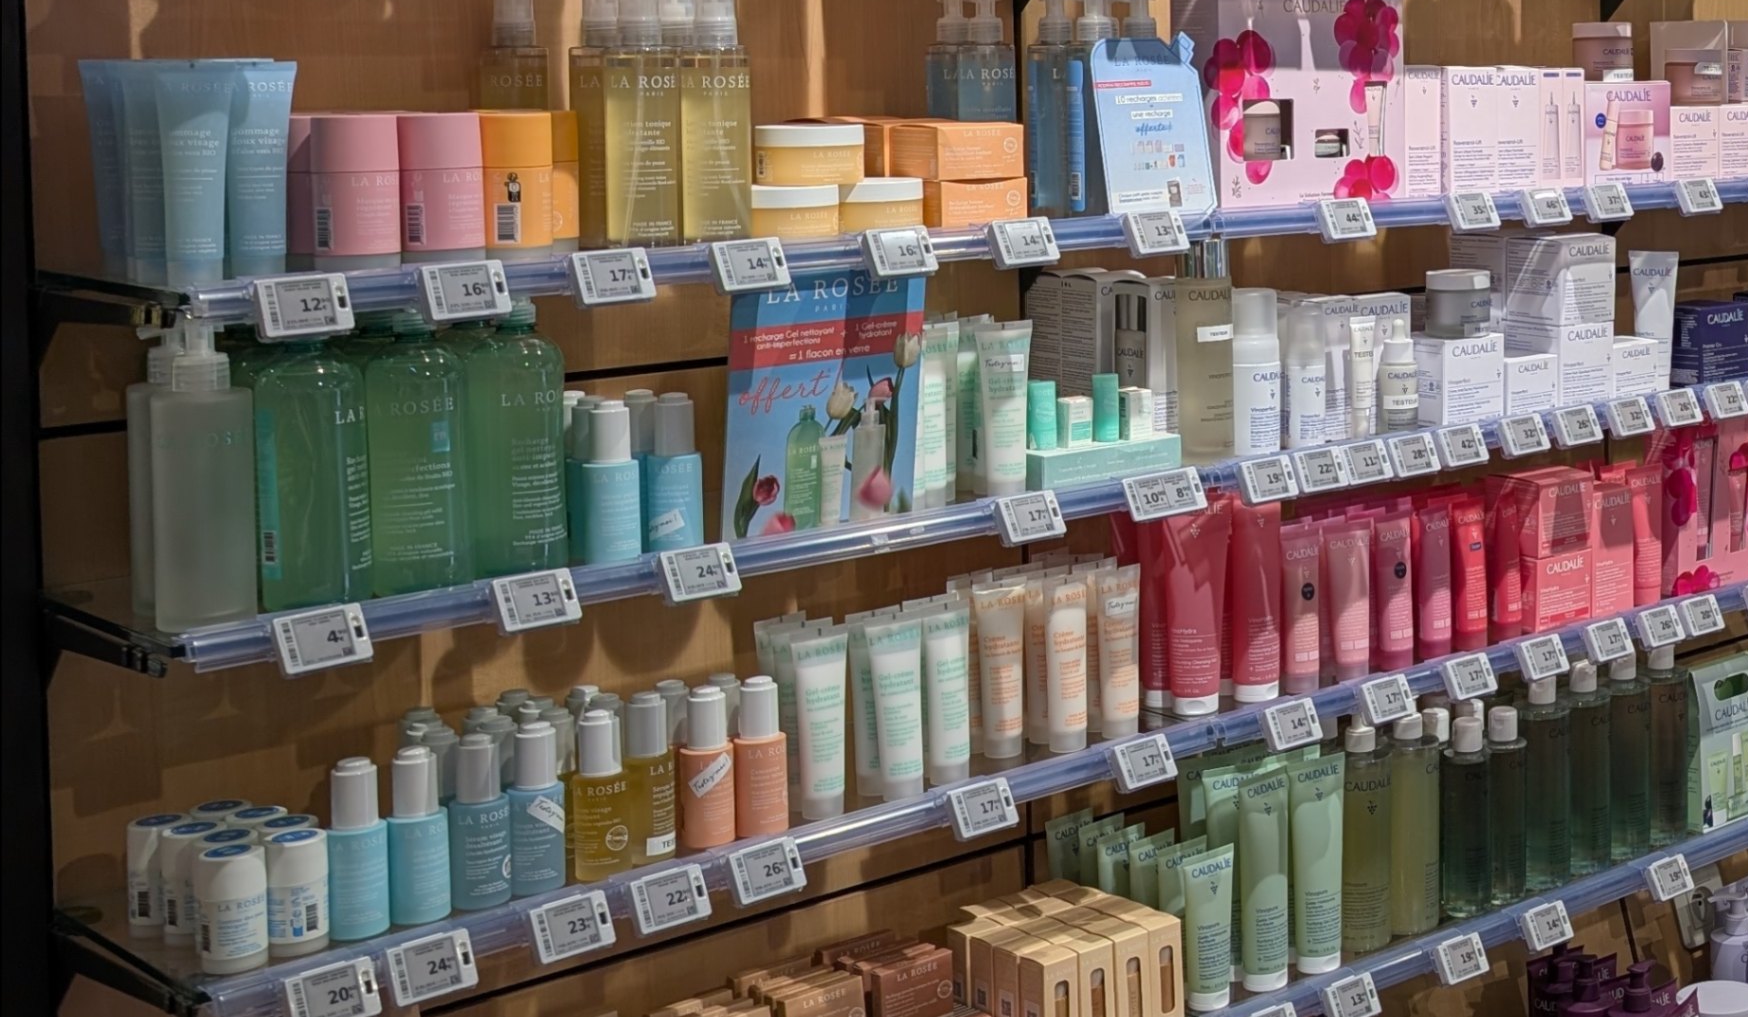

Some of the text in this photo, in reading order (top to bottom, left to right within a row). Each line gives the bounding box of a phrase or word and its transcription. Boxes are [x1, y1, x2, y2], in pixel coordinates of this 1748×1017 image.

[609, 268, 629, 283] 17
[461, 283, 482, 297] 16
[767, 276, 899, 305] LA ROSÉE
[301, 298, 322, 313] 12
[861, 318, 897, 331] Gel-crème
[750, 330, 785, 343] recharge
[785, 329, 799, 340] Gel
[800, 326, 836, 340] nettoyant
[858, 327, 893, 340] hydratant
[805, 347, 832, 360] flacon
[833, 349, 847, 359] en
[848, 344, 871, 355] verre
[335, 408, 356, 424] LA
[696, 564, 715, 578] 24
[533, 592, 551, 607] 13
[327, 629, 338, 643] 4
[458, 814, 475, 826] LA
[567, 920, 587, 934] 23
[427, 960, 447, 975] 24
[328, 990, 348, 1006] 20
